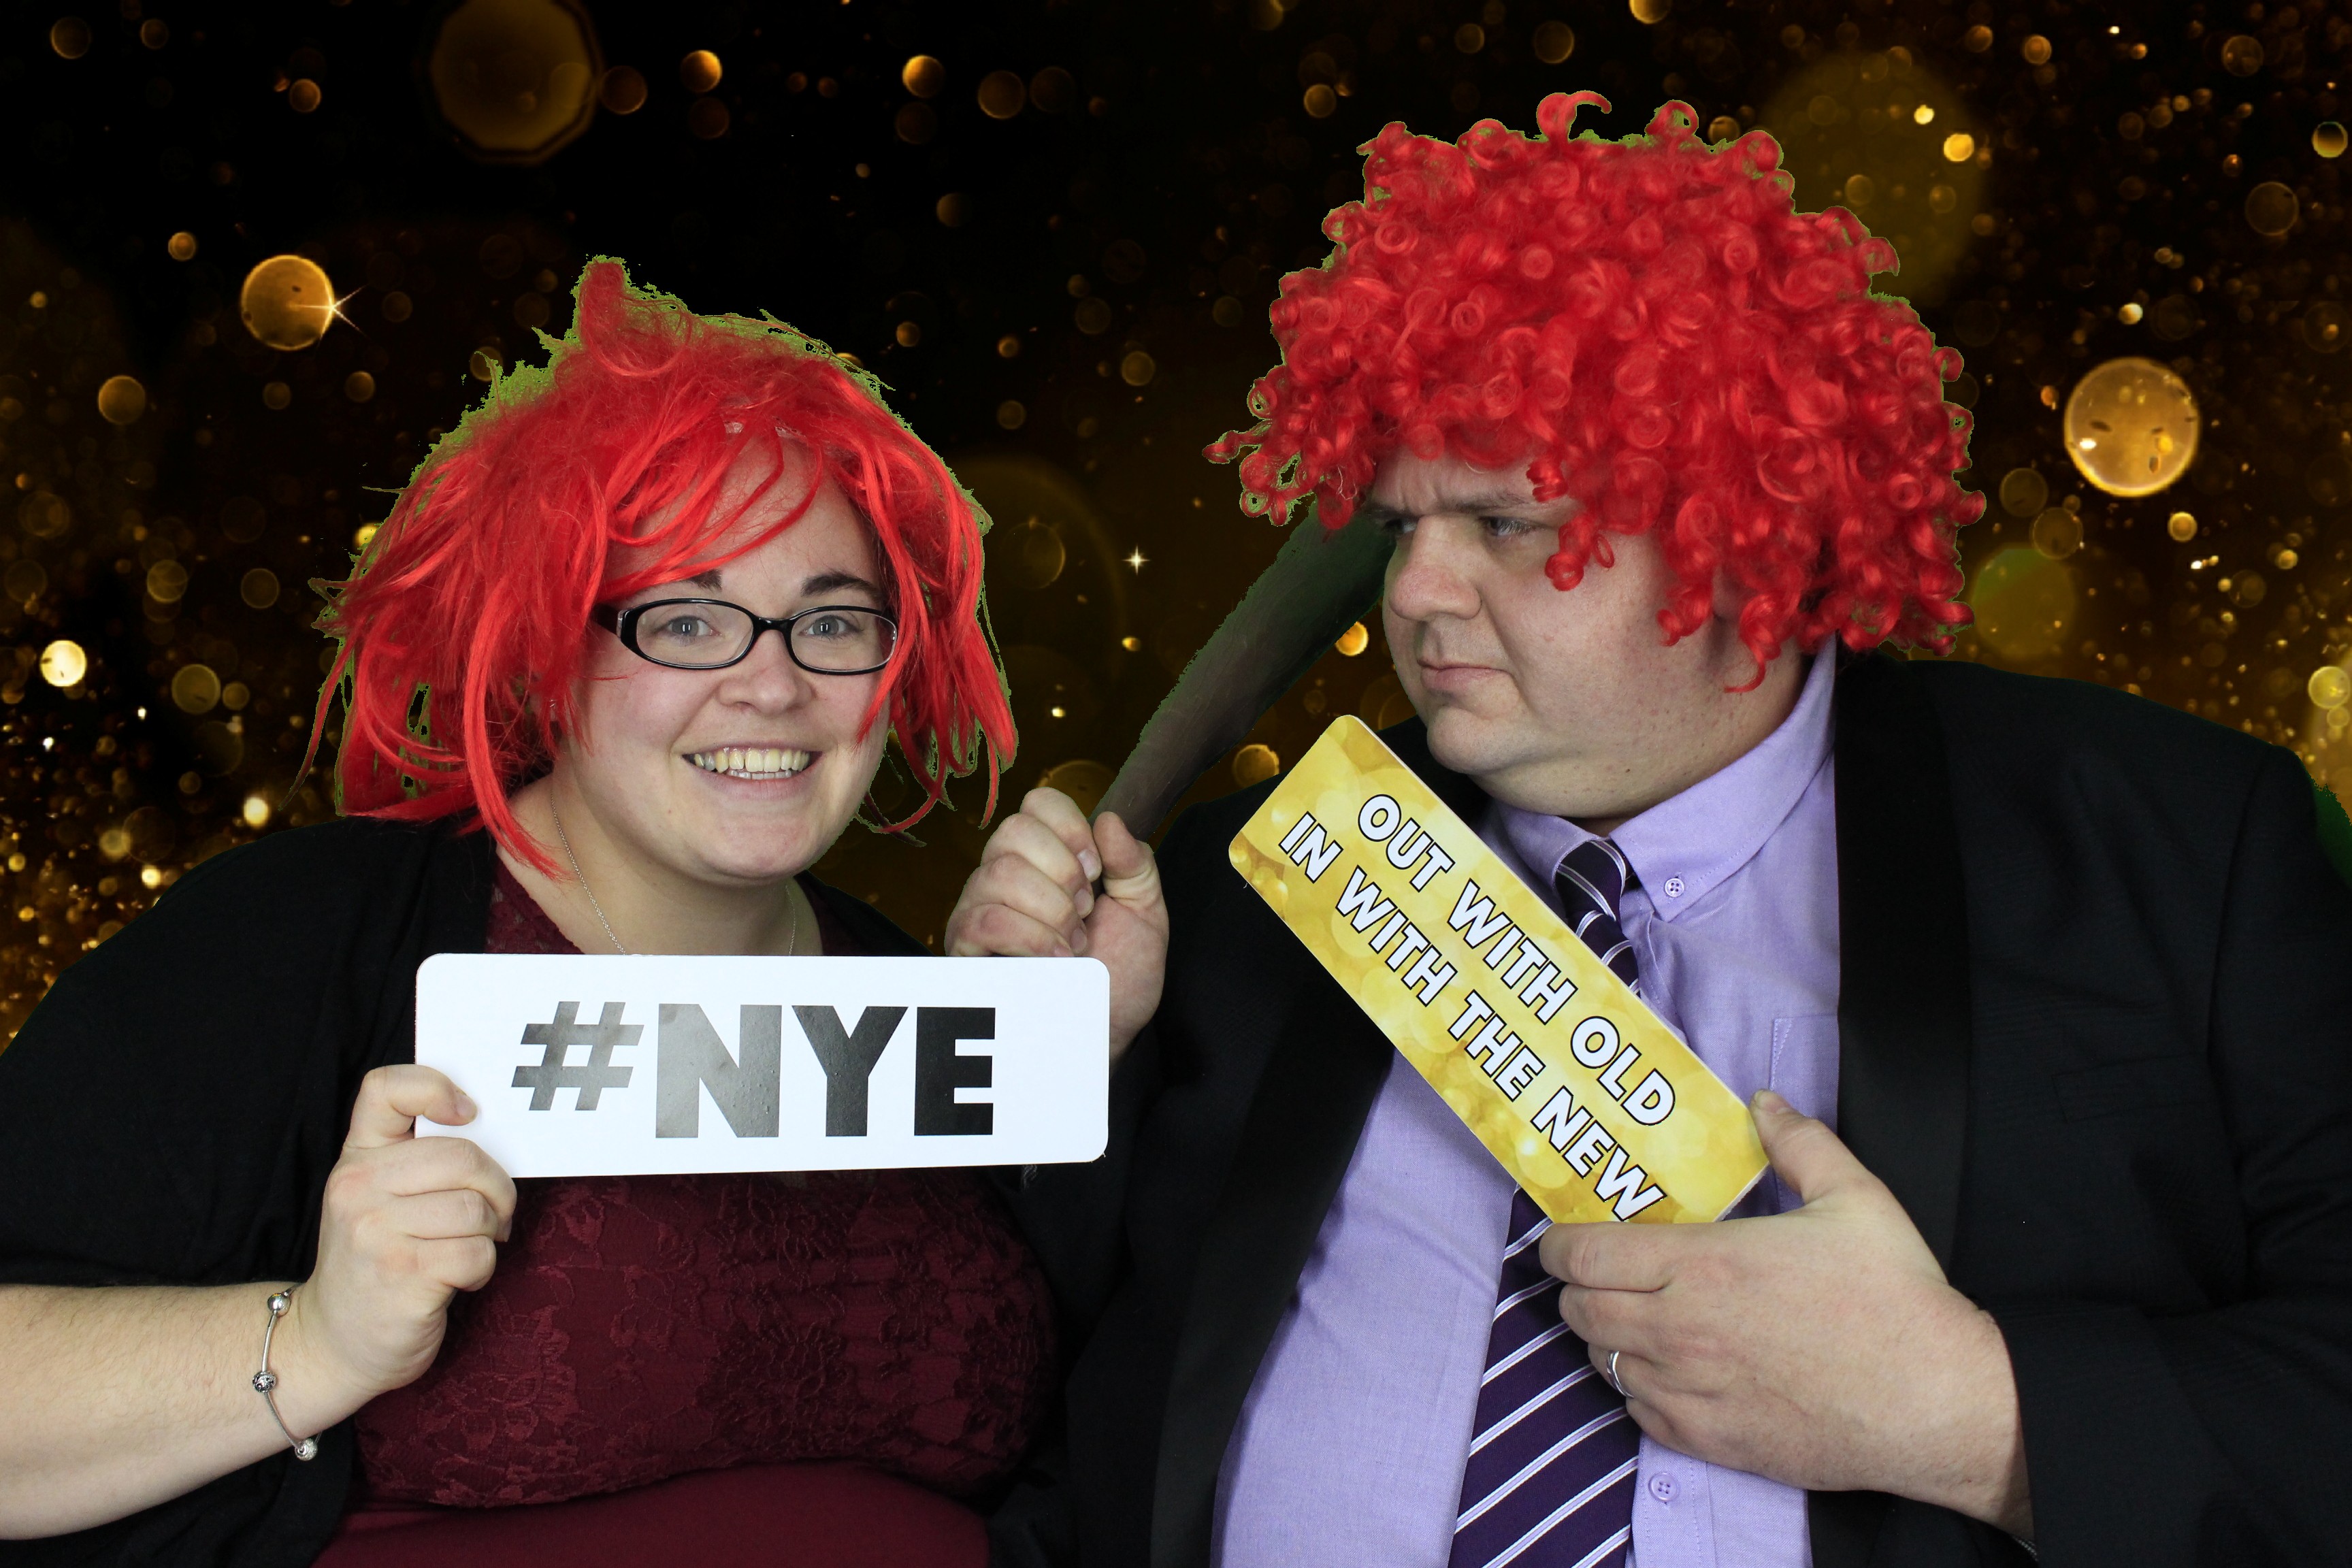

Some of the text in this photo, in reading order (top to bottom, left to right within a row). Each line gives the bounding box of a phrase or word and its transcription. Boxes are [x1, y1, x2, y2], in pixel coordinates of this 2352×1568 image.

[511, 1001, 996, 1138] #NYE
[1279, 812, 1667, 1222] IN WITH THE NEW
[1358, 794, 1675, 1126] OUT WITH OLD
